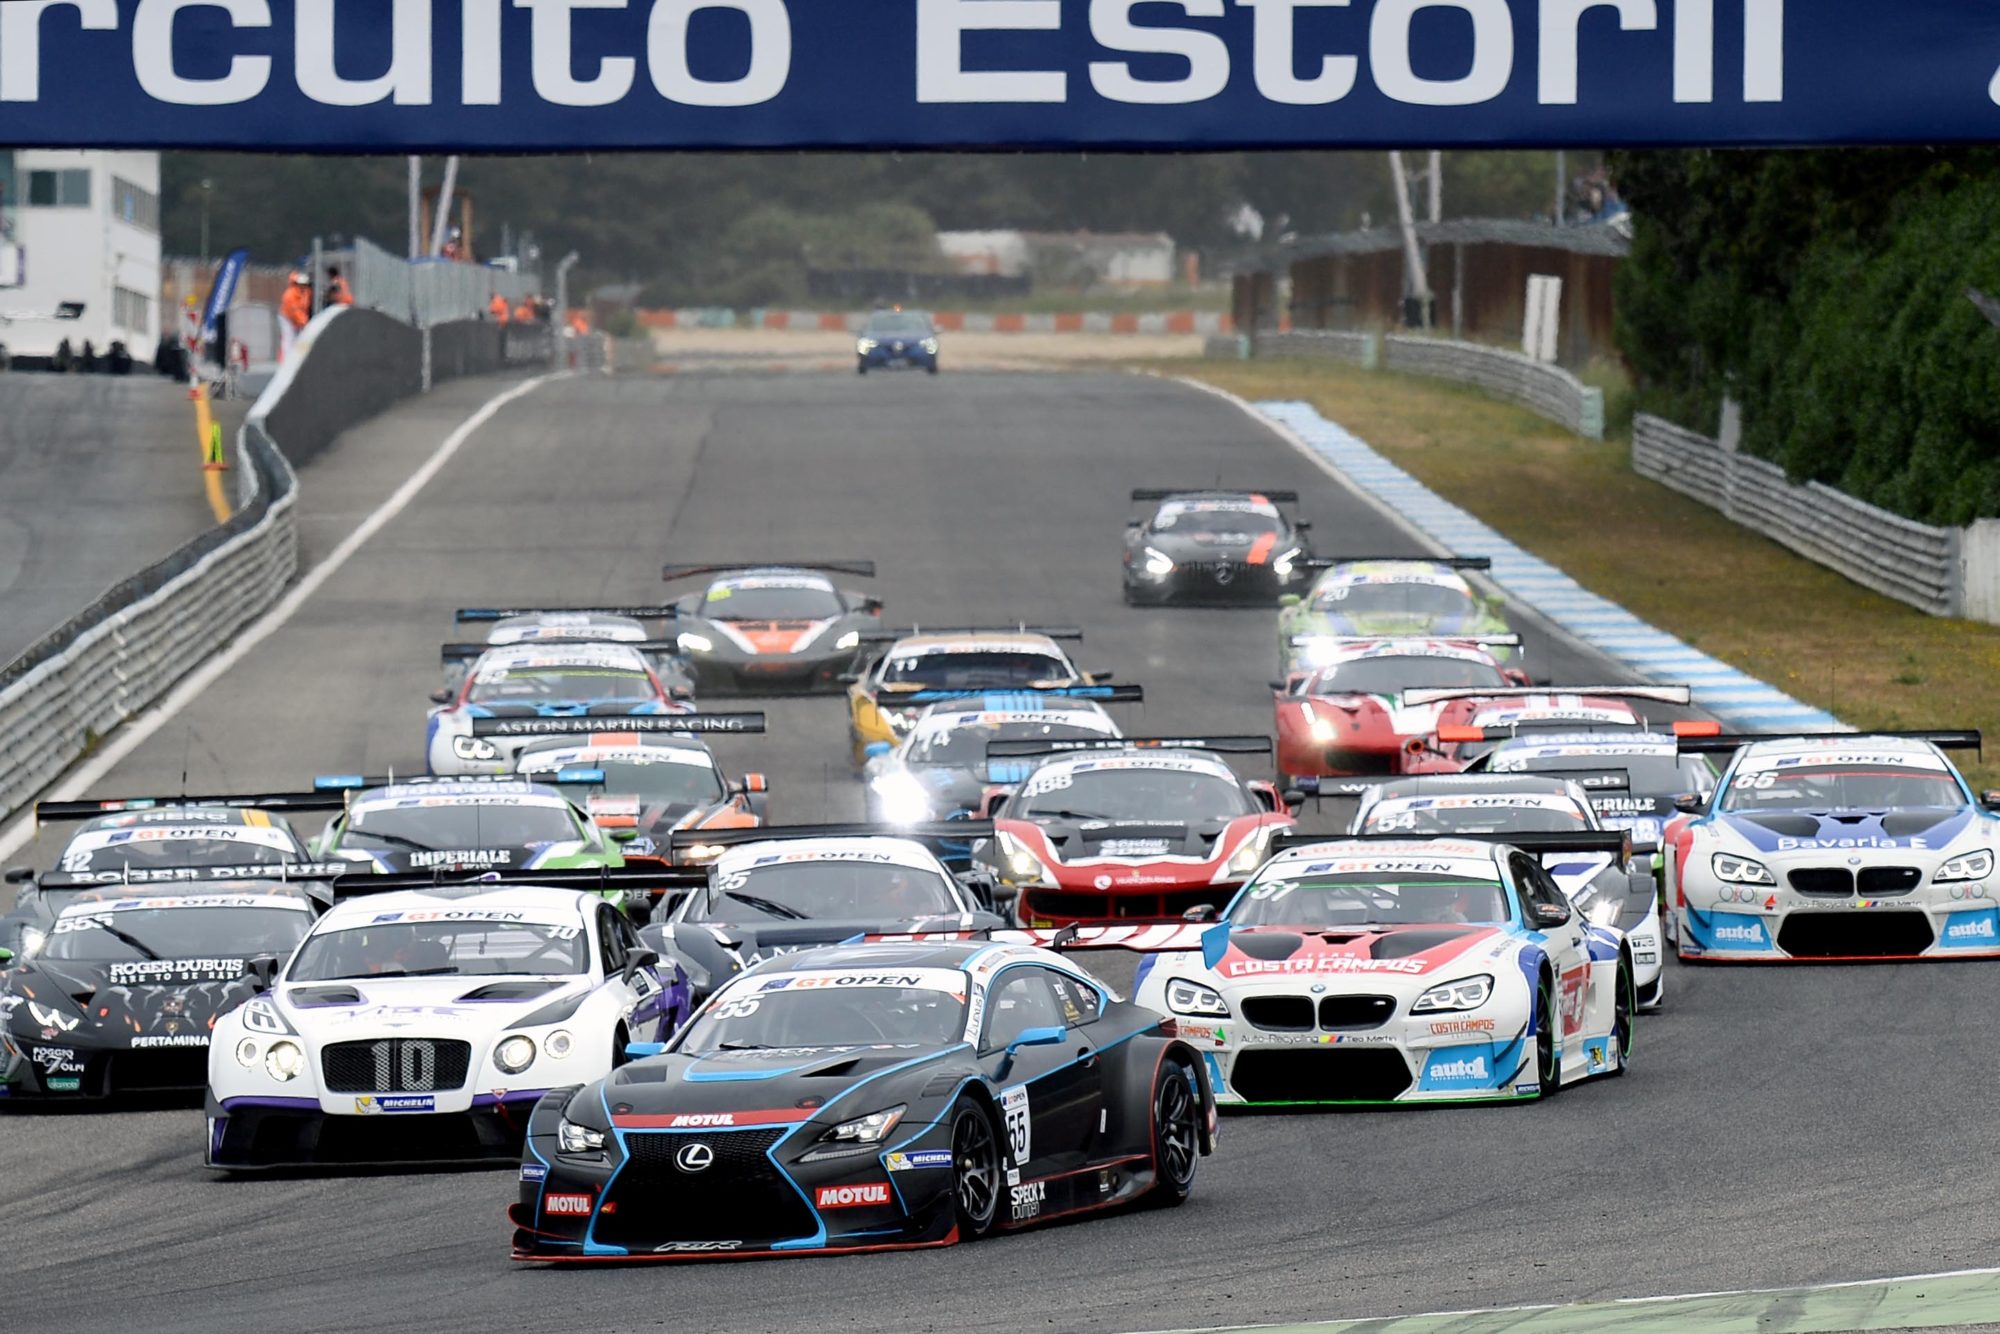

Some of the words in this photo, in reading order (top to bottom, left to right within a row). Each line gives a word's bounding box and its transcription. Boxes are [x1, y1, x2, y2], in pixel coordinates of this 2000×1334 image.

[496, 721, 567, 734] ASTON
[573, 719, 651, 732] MARTIN
[658, 717, 744, 731] RACING
[1020, 773, 1073, 797] 488
[1377, 812, 1416, 832] 54
[1778, 836, 1896, 850] Bavaria
[61, 851, 93, 872] 12
[410, 850, 511, 867] IMPERIALE
[71, 868, 198, 882] ROGER
[53, 915, 115, 934] 555
[110, 961, 176, 976] ROGER
[176, 959, 244, 973] DUBUIS
[1229, 959, 1315, 976] COSTA
[1317, 958, 1427, 974] CAMPOS
[110, 975, 146, 985] DARE
[155, 973, 172, 981] TO
[712, 994, 766, 1021] 55
[1430, 1021, 1460, 1035] COSTA
[1460, 1018, 1495, 1032] CAMPOS
[131, 1035, 210, 1048] PERTAMINA
[1345, 1035, 1364, 1043] Teo
[33, 1047, 74, 1059] POGGIO
[371, 1039, 435, 1092] 10
[383, 1097, 435, 1109] MICHELIN
[670, 1113, 735, 1128] MOTUL
[1008, 1111, 1026, 1153] 55
[820, 1186, 887, 1206] MOTUL
[1011, 1181, 1038, 1206] SPECK
[1038, 1181, 1046, 1201] X
[547, 1194, 590, 1214] MOTUL
